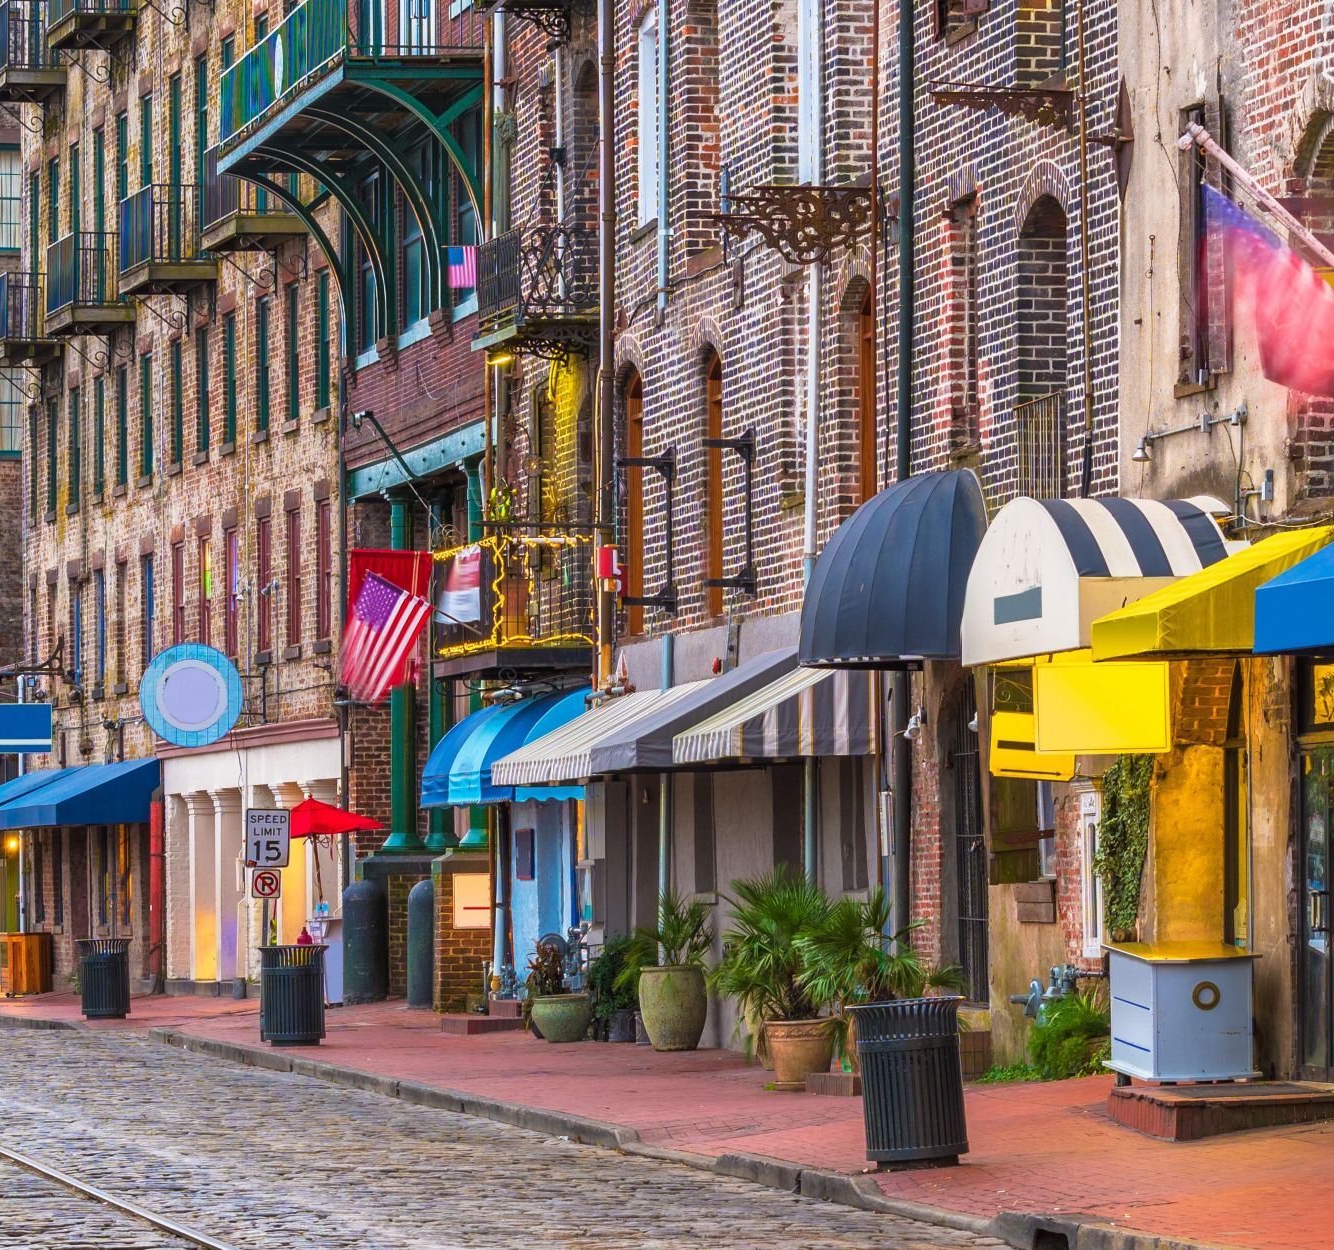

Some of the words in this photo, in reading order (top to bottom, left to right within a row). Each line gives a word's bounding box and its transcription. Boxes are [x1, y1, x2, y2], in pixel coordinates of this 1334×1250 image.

[250, 815, 287, 824] SPEED
[253, 828, 283, 836] LIMIT
[253, 840, 282, 862] 15
